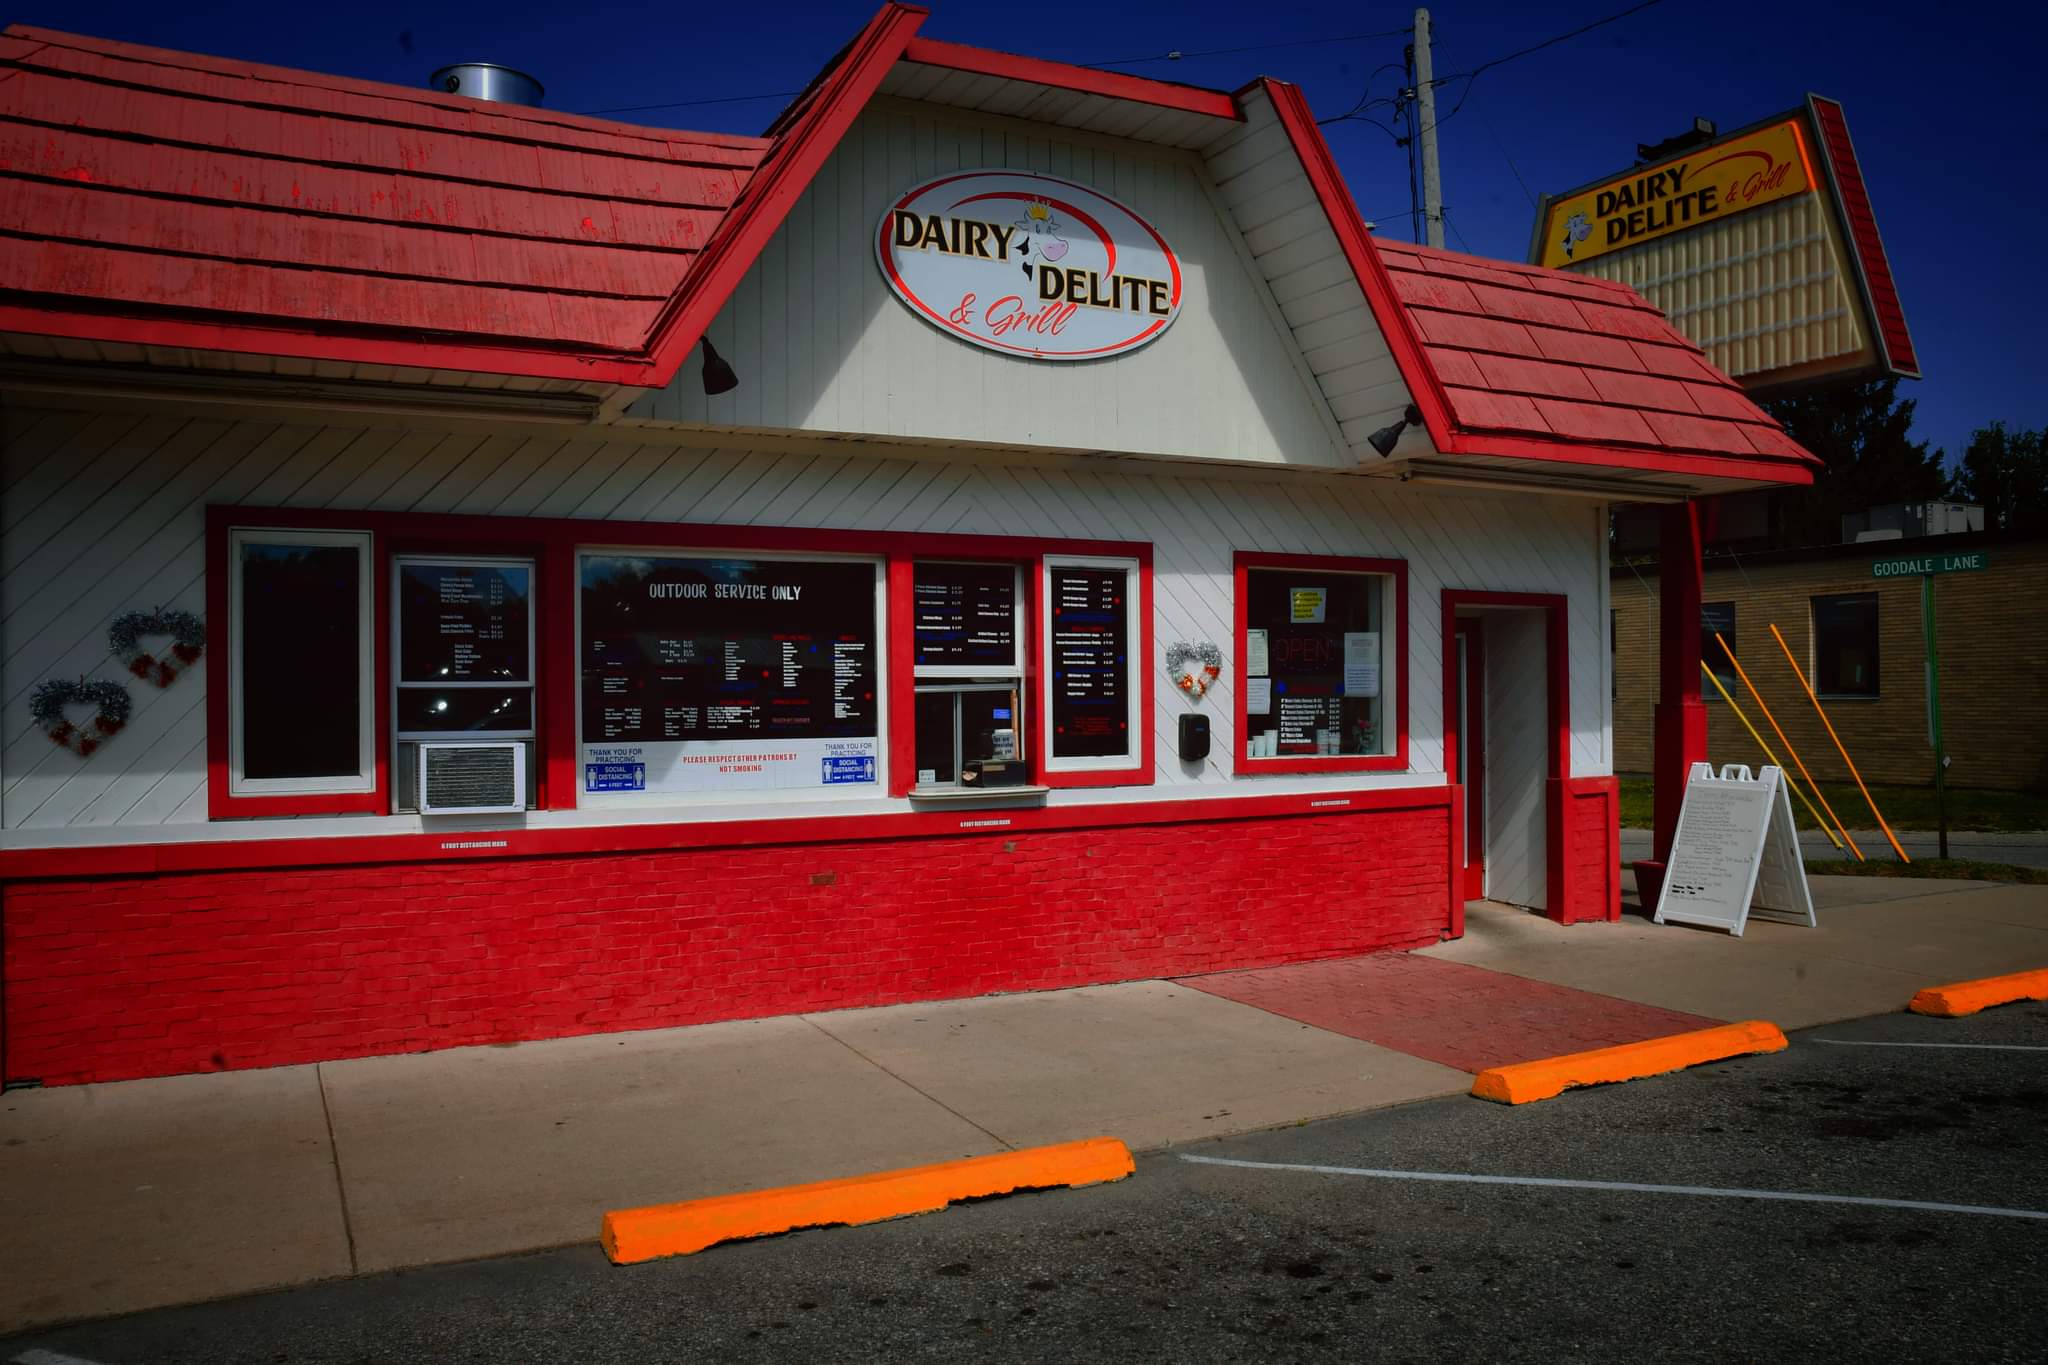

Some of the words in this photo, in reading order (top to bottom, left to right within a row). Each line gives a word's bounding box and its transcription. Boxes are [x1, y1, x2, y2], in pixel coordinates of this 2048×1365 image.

[1596, 164, 1688, 218] DAIRY
[1607, 187, 1719, 245] DELITE
[1725, 182, 1737, 204] &
[1742, 161, 1792, 201] Grill
[894, 209, 1015, 261] DAIRY
[1039, 264, 1171, 316] DELITE
[950, 293, 977, 325] &
[985, 295, 1078, 337] Grill
[1873, 559, 1933, 576] GOODALE
[1943, 554, 1980, 571] LANE
[649, 583, 708, 599] OUTDOOR
[714, 583, 767, 600] SERVICE
[772, 585, 802, 601] ONLY
[1279, 636, 1330, 662] OPEN
[614, 748, 627, 756] YOU
[628, 747, 643, 756] FOR
[825, 743, 845, 751] THANK
[860, 742, 873, 750] FOR
[595, 755, 636, 763] PRACTICING
[683, 755, 708, 764] PLEASE
[709, 755, 736, 764] RESPECT
[737, 754, 757, 763] OTHER
[758, 753, 788, 762] PATRONS
[789, 753, 798, 761] BY
[838, 758, 858, 766] SOCIAL
[598, 773, 633, 781] DISTANCING
[719, 766, 732, 774] NOT
[733, 765, 762, 774] SMOKING
